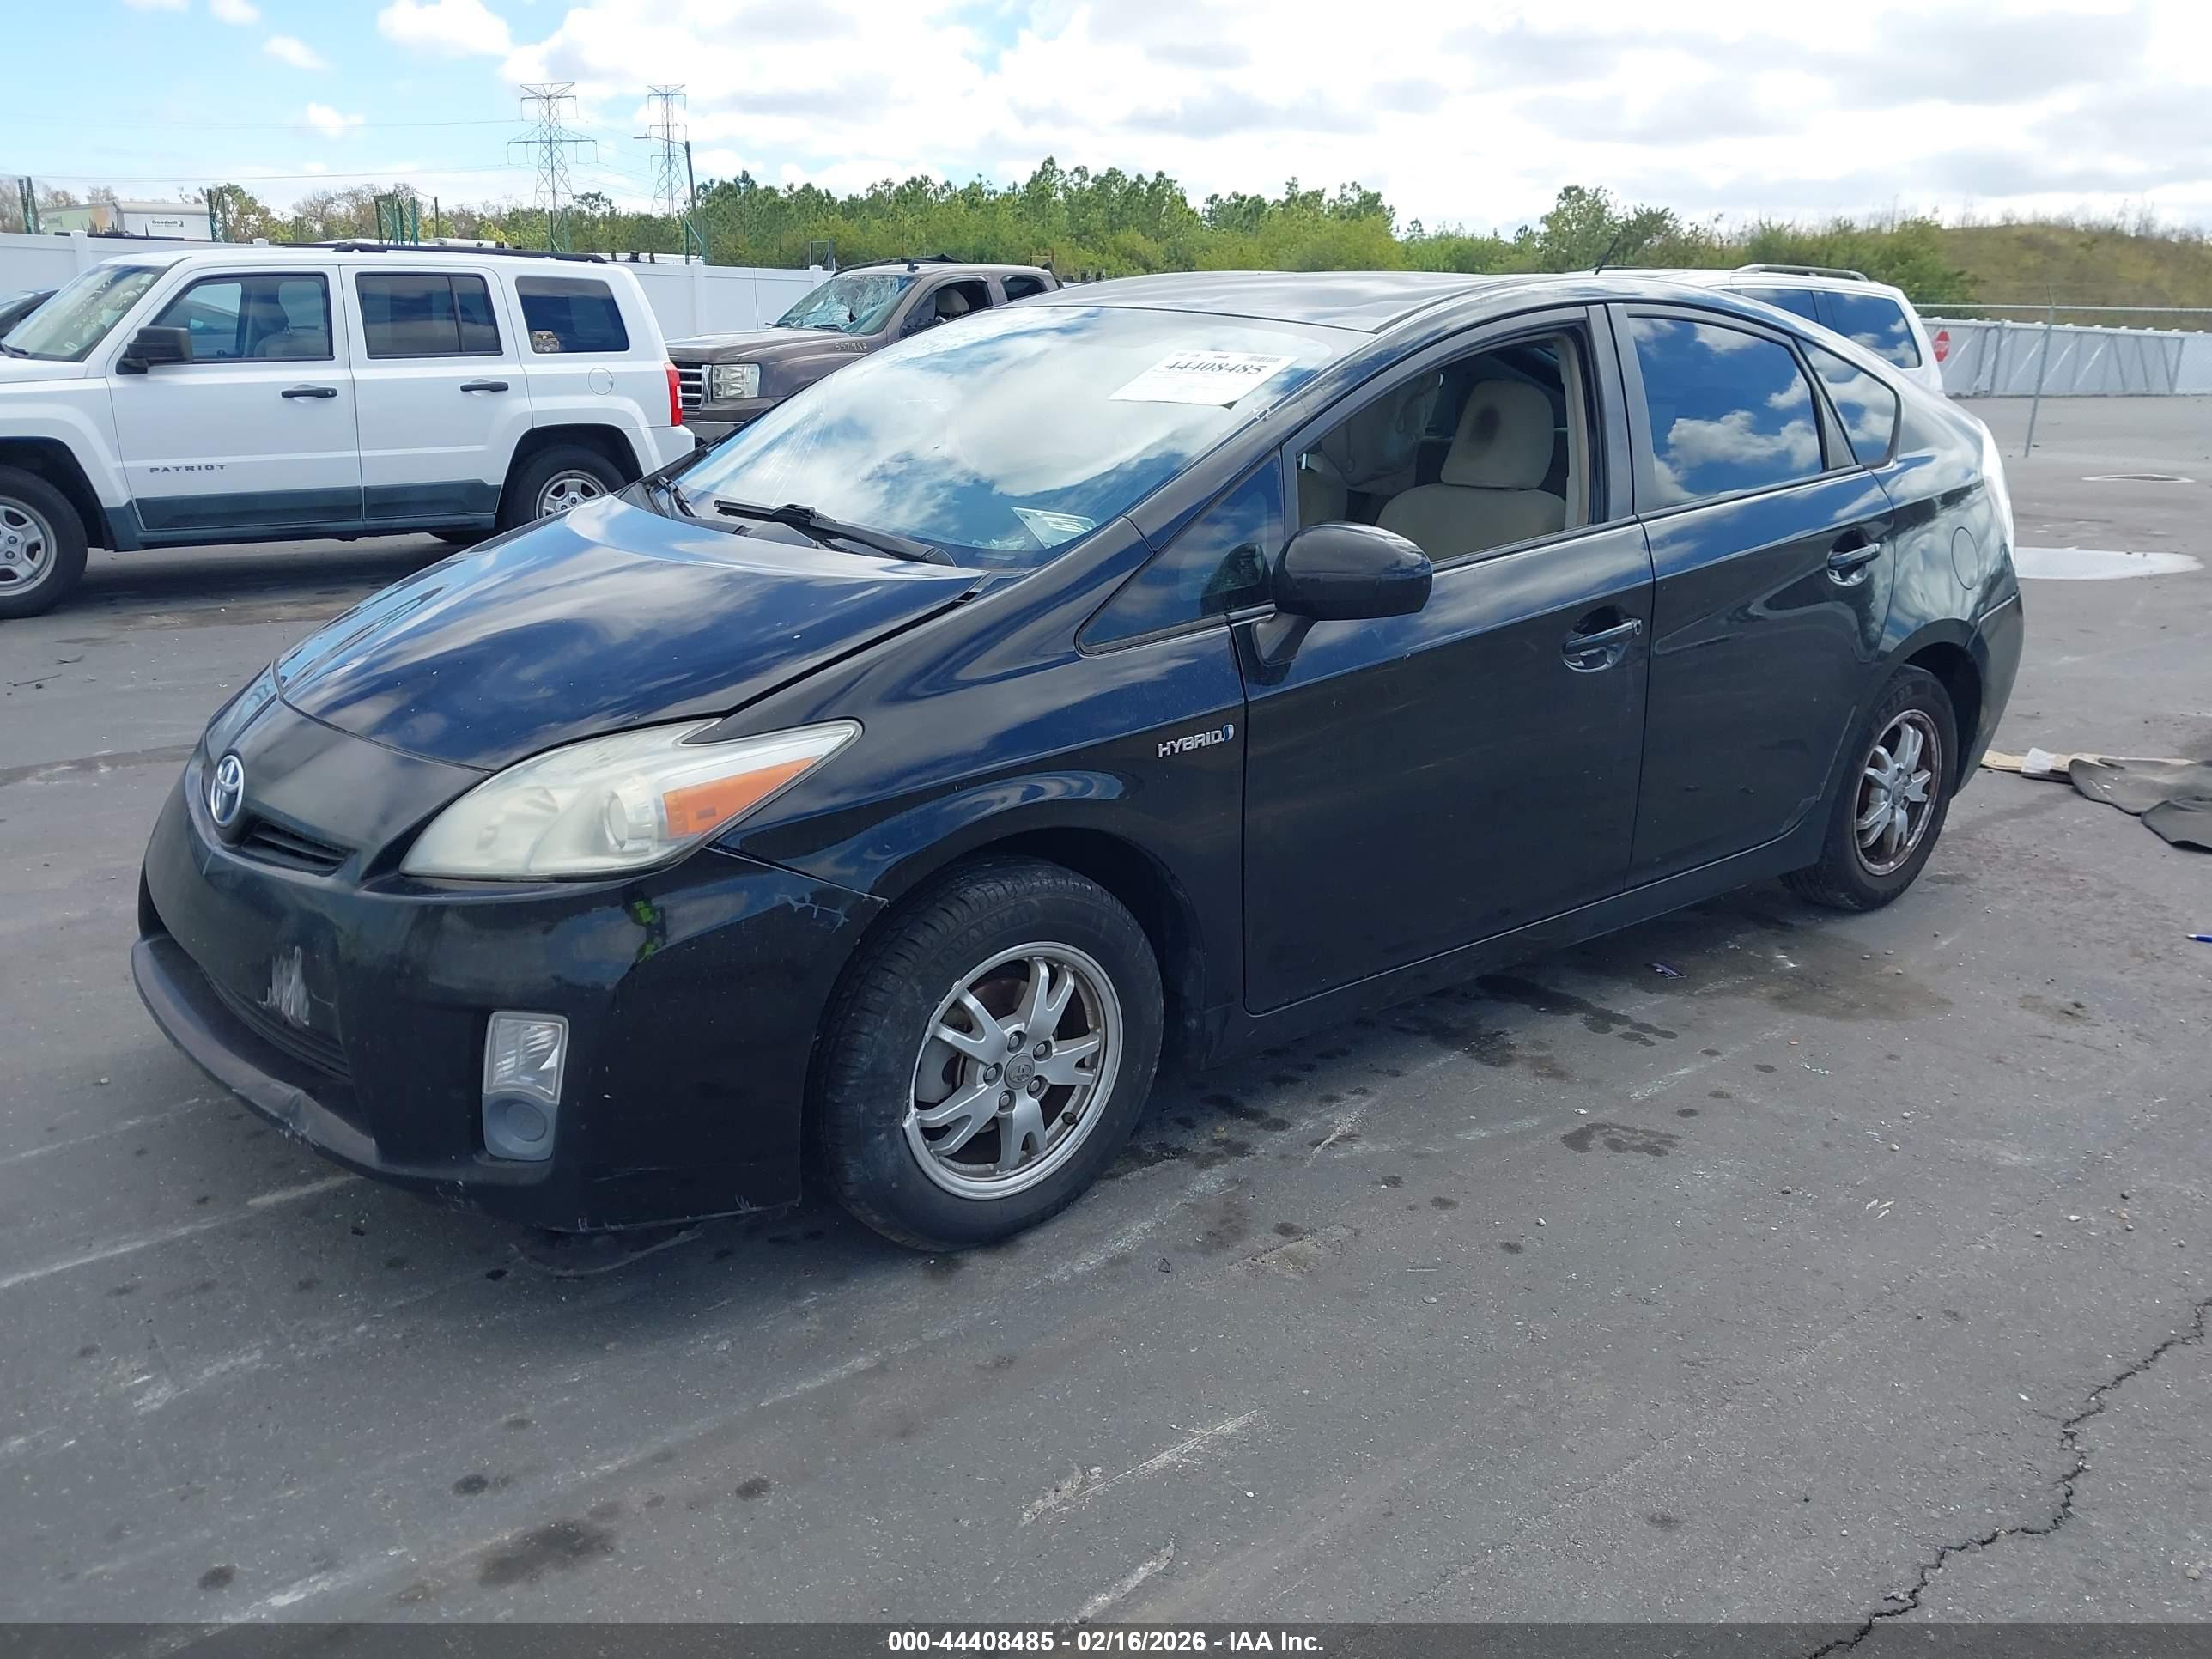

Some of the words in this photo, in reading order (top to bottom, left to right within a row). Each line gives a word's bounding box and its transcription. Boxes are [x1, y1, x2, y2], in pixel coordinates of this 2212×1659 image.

[1165, 361, 1268, 374] 44408485
[149, 465, 227, 473] PATRIOT
[1158, 729, 1224, 757] HYBRID
